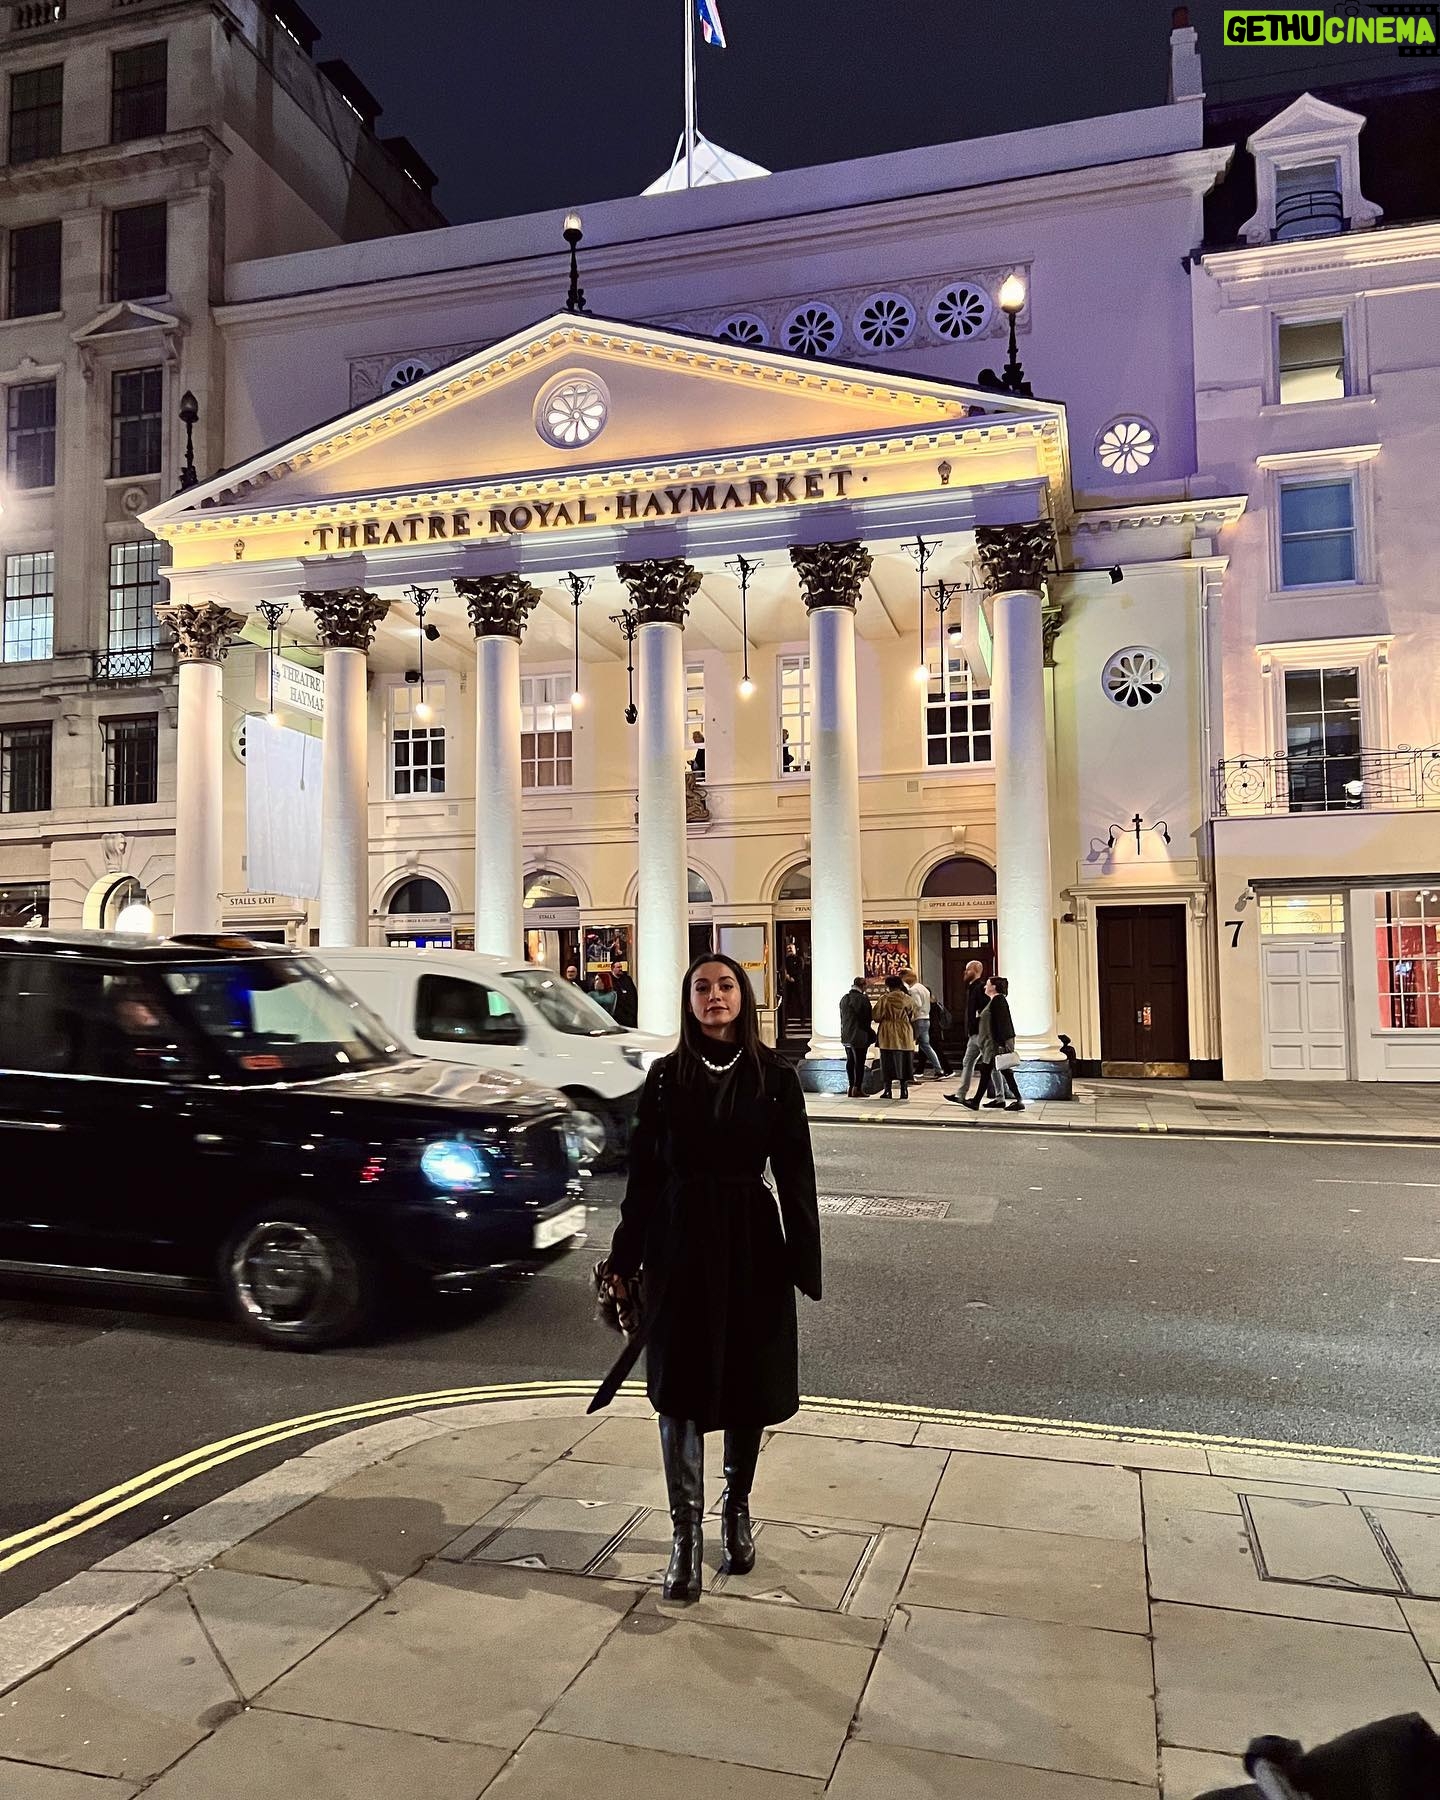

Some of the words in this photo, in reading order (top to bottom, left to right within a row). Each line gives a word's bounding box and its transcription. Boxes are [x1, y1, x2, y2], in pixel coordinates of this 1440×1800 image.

[312, 512, 472, 551] THEATRE
[488, 499, 597, 536] ROYAL
[615, 469, 852, 521] HAYMARKET
[282, 664, 321, 692] THEATRE
[230, 897, 257, 906] STALLS
[258, 896, 276, 905] EXIT
[1225, 920, 1245, 948] 7
